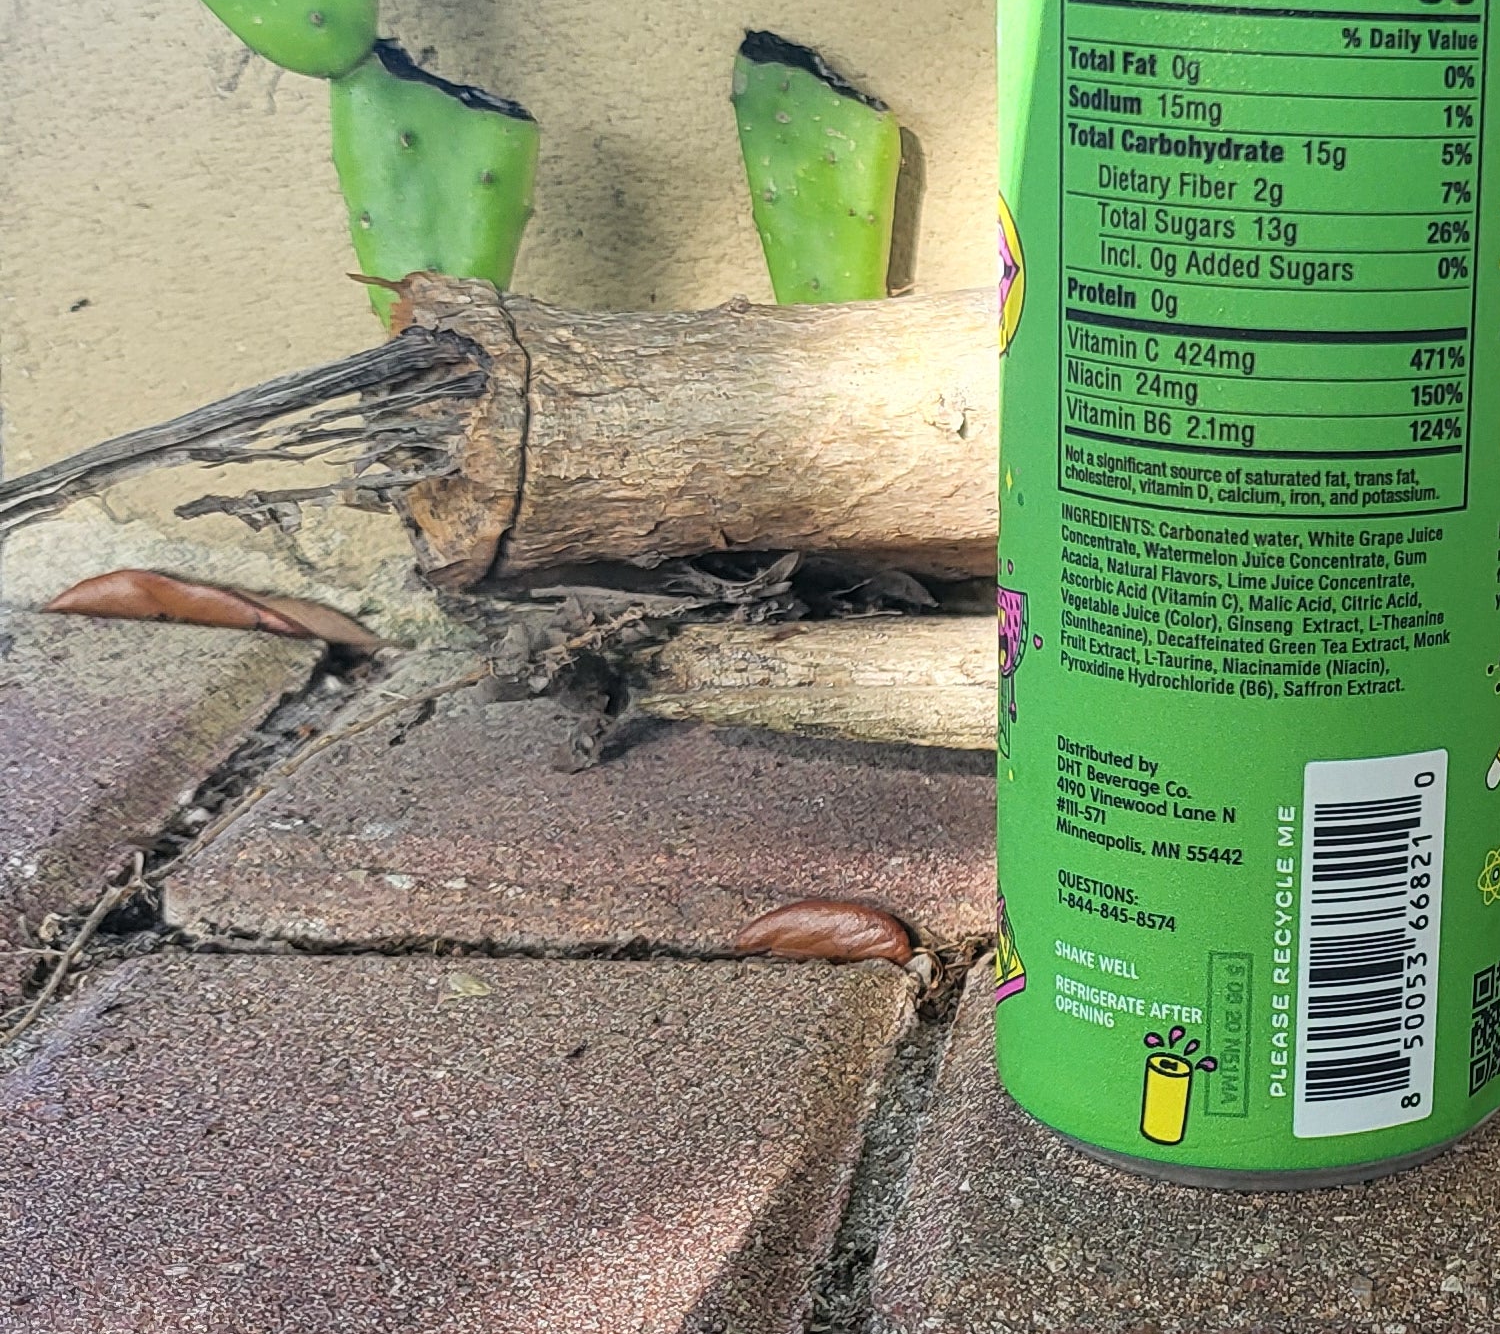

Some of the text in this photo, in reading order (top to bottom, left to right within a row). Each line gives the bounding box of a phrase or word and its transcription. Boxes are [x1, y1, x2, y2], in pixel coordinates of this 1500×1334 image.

[1342, 27, 1478, 53] % Daily Value
[1068, 46, 1474, 89] Total Fat 0g 0%
[1069, 85, 1473, 128] Sodium 15mg 1%
[1068, 122, 1472, 171] Total Carbohydrate 15g 5%
[1099, 164, 1471, 207] Dietary Fiber 2g 7%
[1098, 202, 1469, 247] Total Sugars 13g 26%
[1102, 240, 1468, 285] Incl. 0g Added Sugars 0%
[1068, 277, 1177, 318] Protein 0g
[1068, 325, 1464, 375] Vitamin C 424mg 471%
[1068, 360, 1463, 406] Niacin 24mg 150%
[1067, 396, 1461, 448] Vitamin B6 2.1mg 124%
[1065, 464, 1439, 508] cholesterol, vitamin D, calcium, iron, and potassium.
[1066, 444, 1419, 489] Not a significant source of saturated fat, trans fat,
[1061, 503, 1155, 537] INGREDIENTS:
[1159, 522, 1249, 545] Carbonated
[1308, 531, 1354, 547] White
[1360, 531, 1403, 548] Grape
[1407, 527, 1442, 543] Juice
[1061, 524, 1426, 570] Concentrate, Watermelon Juice Concentrate, Gum
[1061, 547, 1415, 591] Acacia, Natural Flavors, Lime Juice Concentrate,
[1061, 569, 1114, 594] Ascorbic
[1116, 581, 1147, 600] Acid
[1152, 586, 1216, 608] (Vitamin
[1249, 595, 1292, 611] Malic
[1297, 595, 1337, 614] Acid,
[1342, 595, 1382, 611] Citric
[1386, 589, 1422, 610] Acid,
[1060, 588, 1444, 636] Vegetable Juice (Color), Ginseng Extract, L-Theanine
[1061, 609, 1450, 654] (Suntheanine), Decaffeinated Green Tea Extract, Monk
[1061, 631, 1389, 679] Fruit Extract, L-Taurine, Niacinamide (Niacin),
[1061, 650, 1404, 699] Pyroxidine Hydrochloride (B6), Saffron Extract.
[1057, 735, 1158, 778] Distributed by
[1058, 755, 1193, 799] DHT Beverage Co.
[1056, 797, 1106, 825] #111-571
[1057, 776, 1236, 823] 4190 Vinewood Lane N
[1056, 816, 1244, 865] Minneapolis, MN 55442
[1058, 869, 1139, 906] QUESTIONS:
[1058, 889, 1176, 932] 1-844-845-8574
[1056, 940, 1139, 979] SHAKE WELL
[1270, 807, 1295, 1096] PLEASE RECYCLE ME
[1401, 772, 1435, 1108] 8 50053 66821 0
[1055, 975, 1202, 1024] REFRIGERATE AFTER
[1055, 995, 1115, 1028] OPENING
